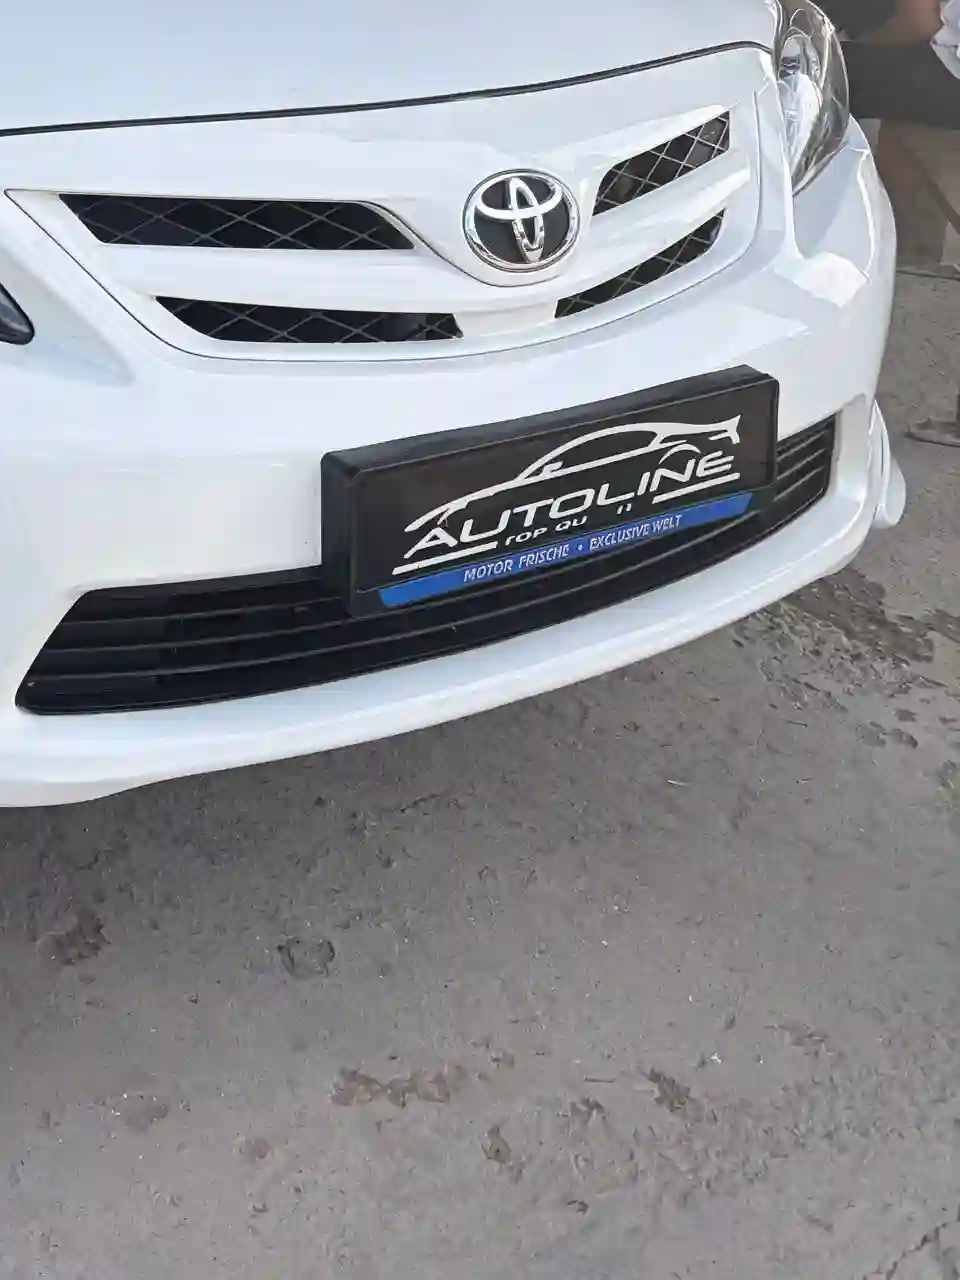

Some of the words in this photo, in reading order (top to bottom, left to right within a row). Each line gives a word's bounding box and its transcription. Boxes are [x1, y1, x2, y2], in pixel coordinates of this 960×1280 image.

[404, 448, 735, 559] AUTOLINE
[463, 559, 513, 582] MOTOR
[518, 543, 570, 568] FRISCHE
[590, 523, 650, 551] EXCLUSIVE
[652, 515, 682, 533] WELT
